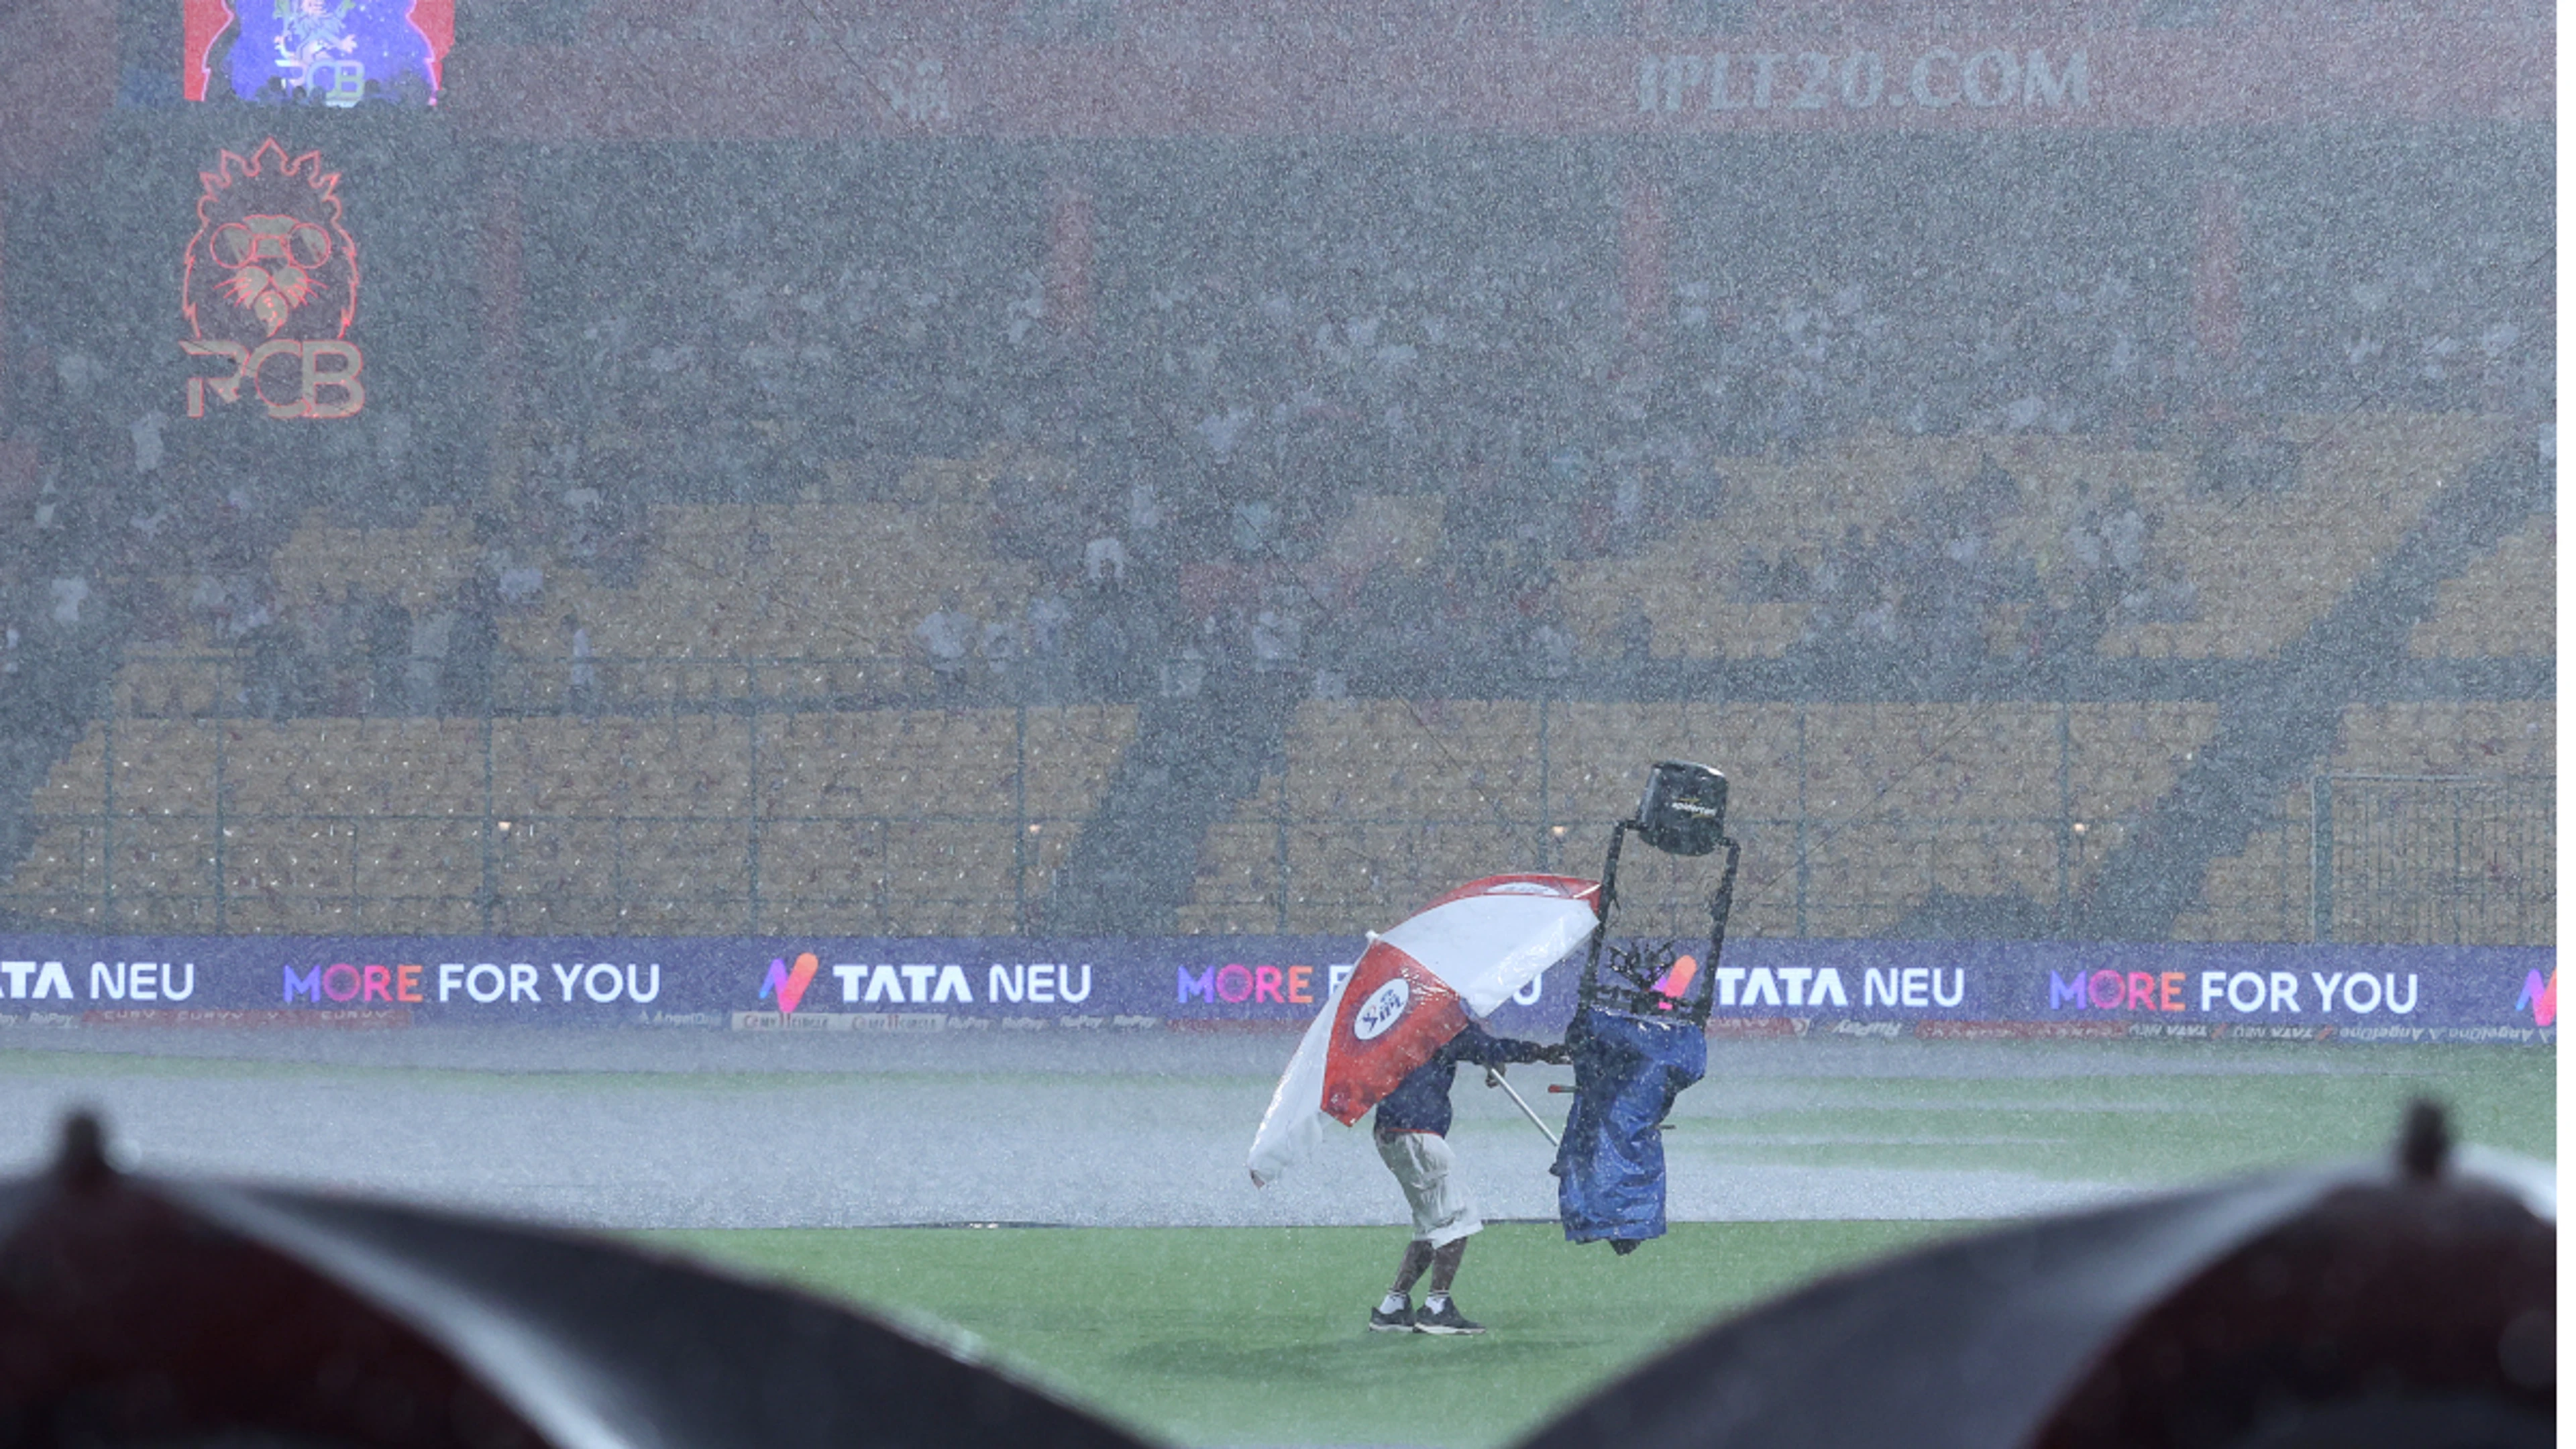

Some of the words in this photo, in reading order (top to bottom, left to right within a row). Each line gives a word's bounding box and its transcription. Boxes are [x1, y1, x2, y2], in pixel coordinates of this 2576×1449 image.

[1637, 44, 2090, 113] IPLT20.COM
[178, 339, 366, 419] RCB
[0, 961, 73, 999] TA
[90, 962, 194, 1000] NEU
[283, 964, 423, 1002] MORE
[439, 963, 540, 1002] FOR
[552, 963, 659, 1002] YOU
[833, 965, 973, 1002] TATA
[989, 964, 1091, 1003] NEU
[1177, 964, 1313, 1004] MORE
[1715, 967, 1847, 1006] TATA
[1864, 967, 1964, 1007] NEU
[2049, 970, 2186, 1011] MORE
[2202, 971, 2300, 1012] FOR
[2312, 972, 2418, 1014] YOU
